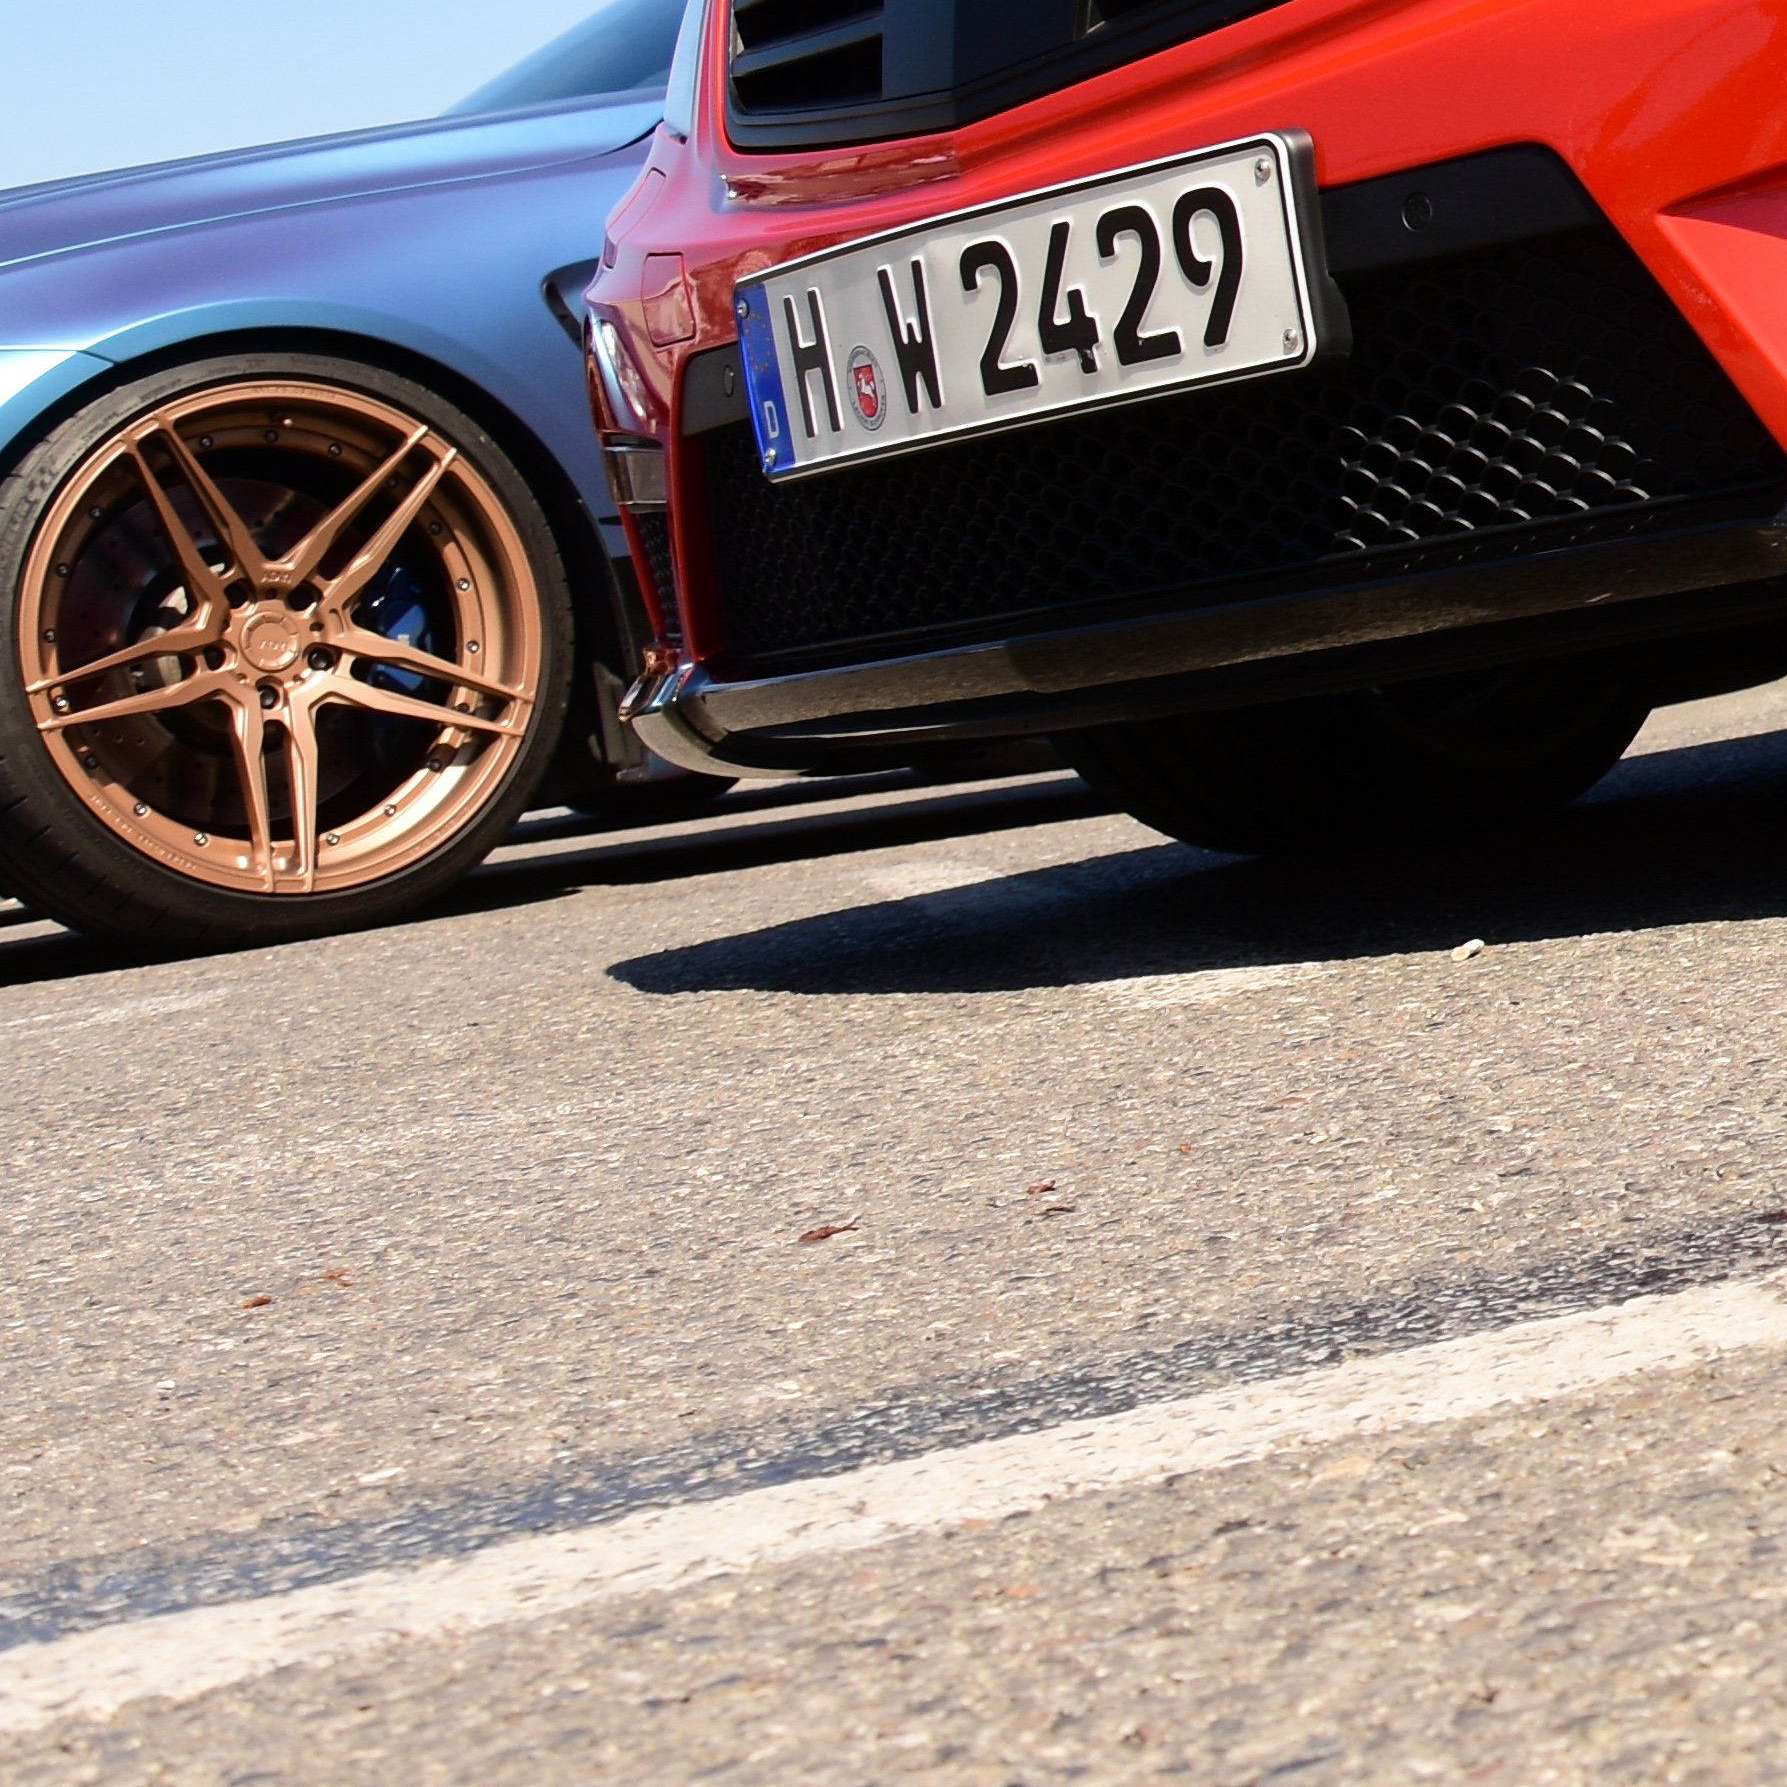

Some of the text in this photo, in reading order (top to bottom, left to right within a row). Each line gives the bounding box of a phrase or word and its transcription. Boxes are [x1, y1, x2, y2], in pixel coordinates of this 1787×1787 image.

[783, 286, 843, 440] H
[877, 257, 943, 414] W
[959, 185, 1244, 396] 2429
[762, 399, 779, 438] D
